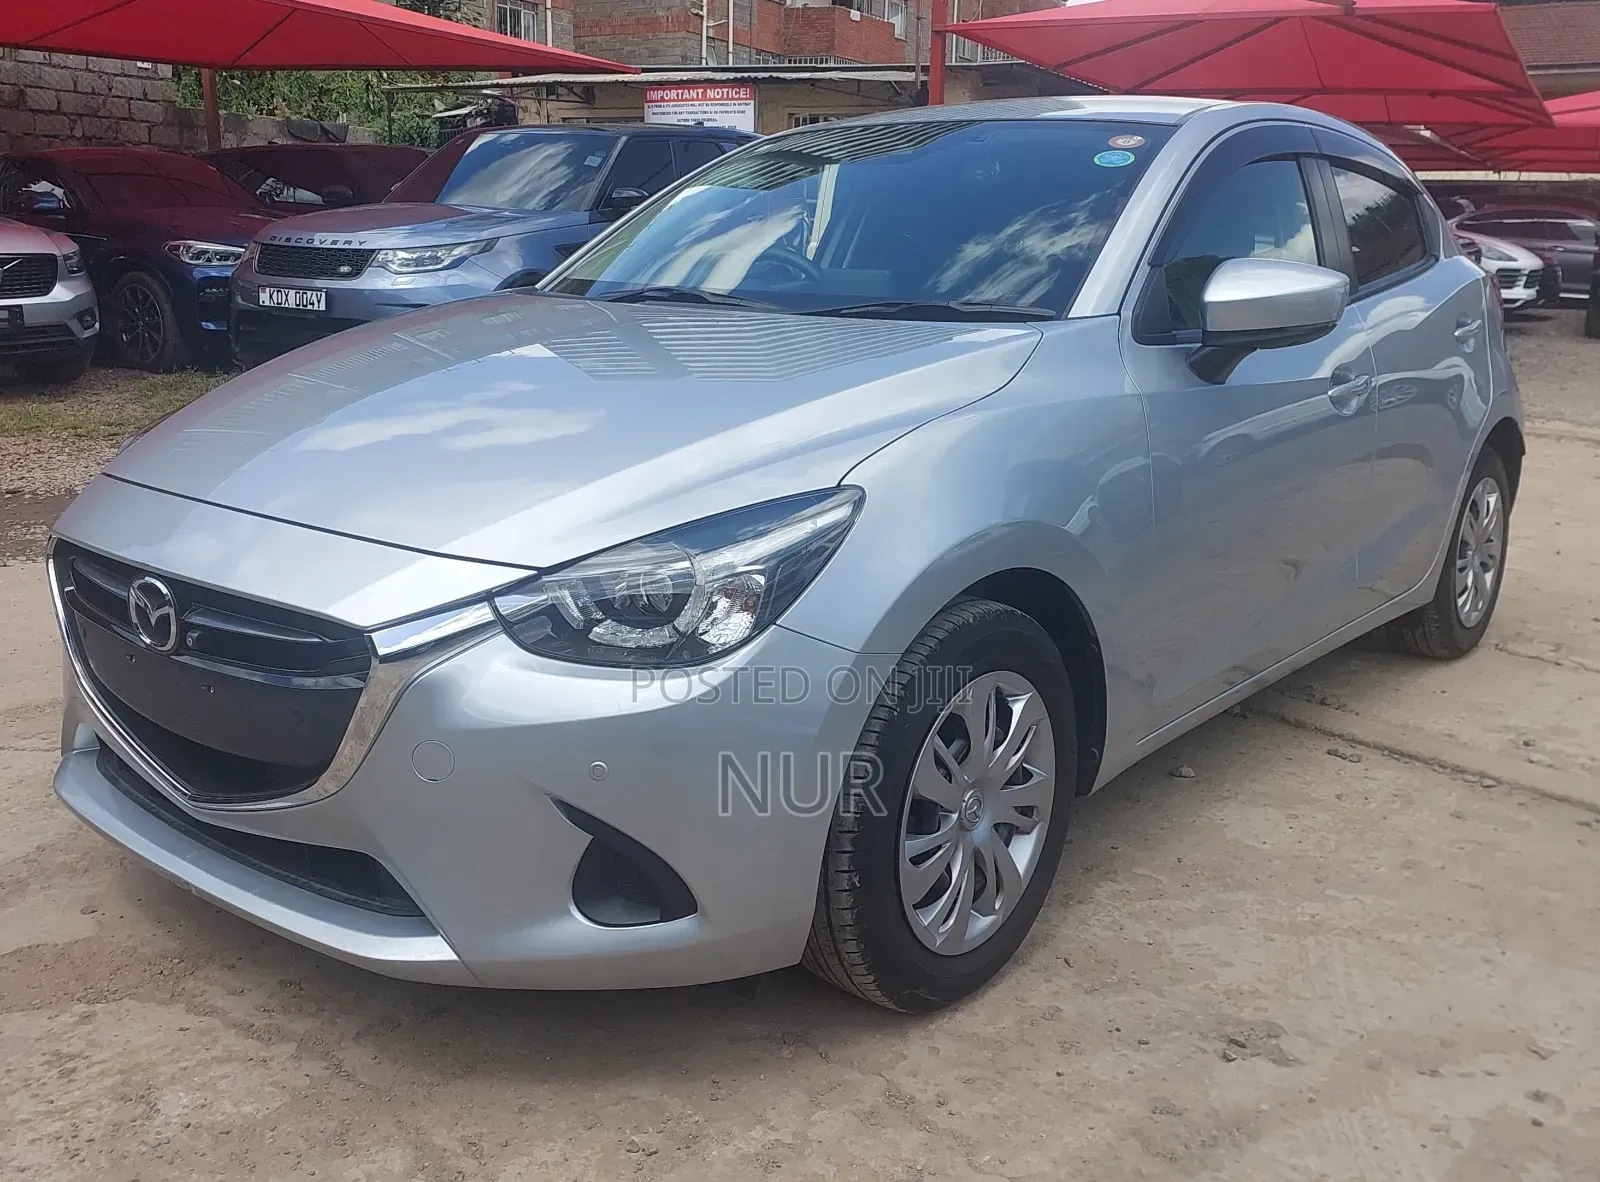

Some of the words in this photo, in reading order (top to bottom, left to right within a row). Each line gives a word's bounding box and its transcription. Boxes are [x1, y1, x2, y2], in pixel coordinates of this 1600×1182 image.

[646, 89, 703, 101] IMPORTANT
[706, 87, 750, 99] NOTICE!
[269, 235, 368, 247] DISCOVERY
[268, 288, 291, 307] KDX
[294, 291, 323, 310] 004Y
